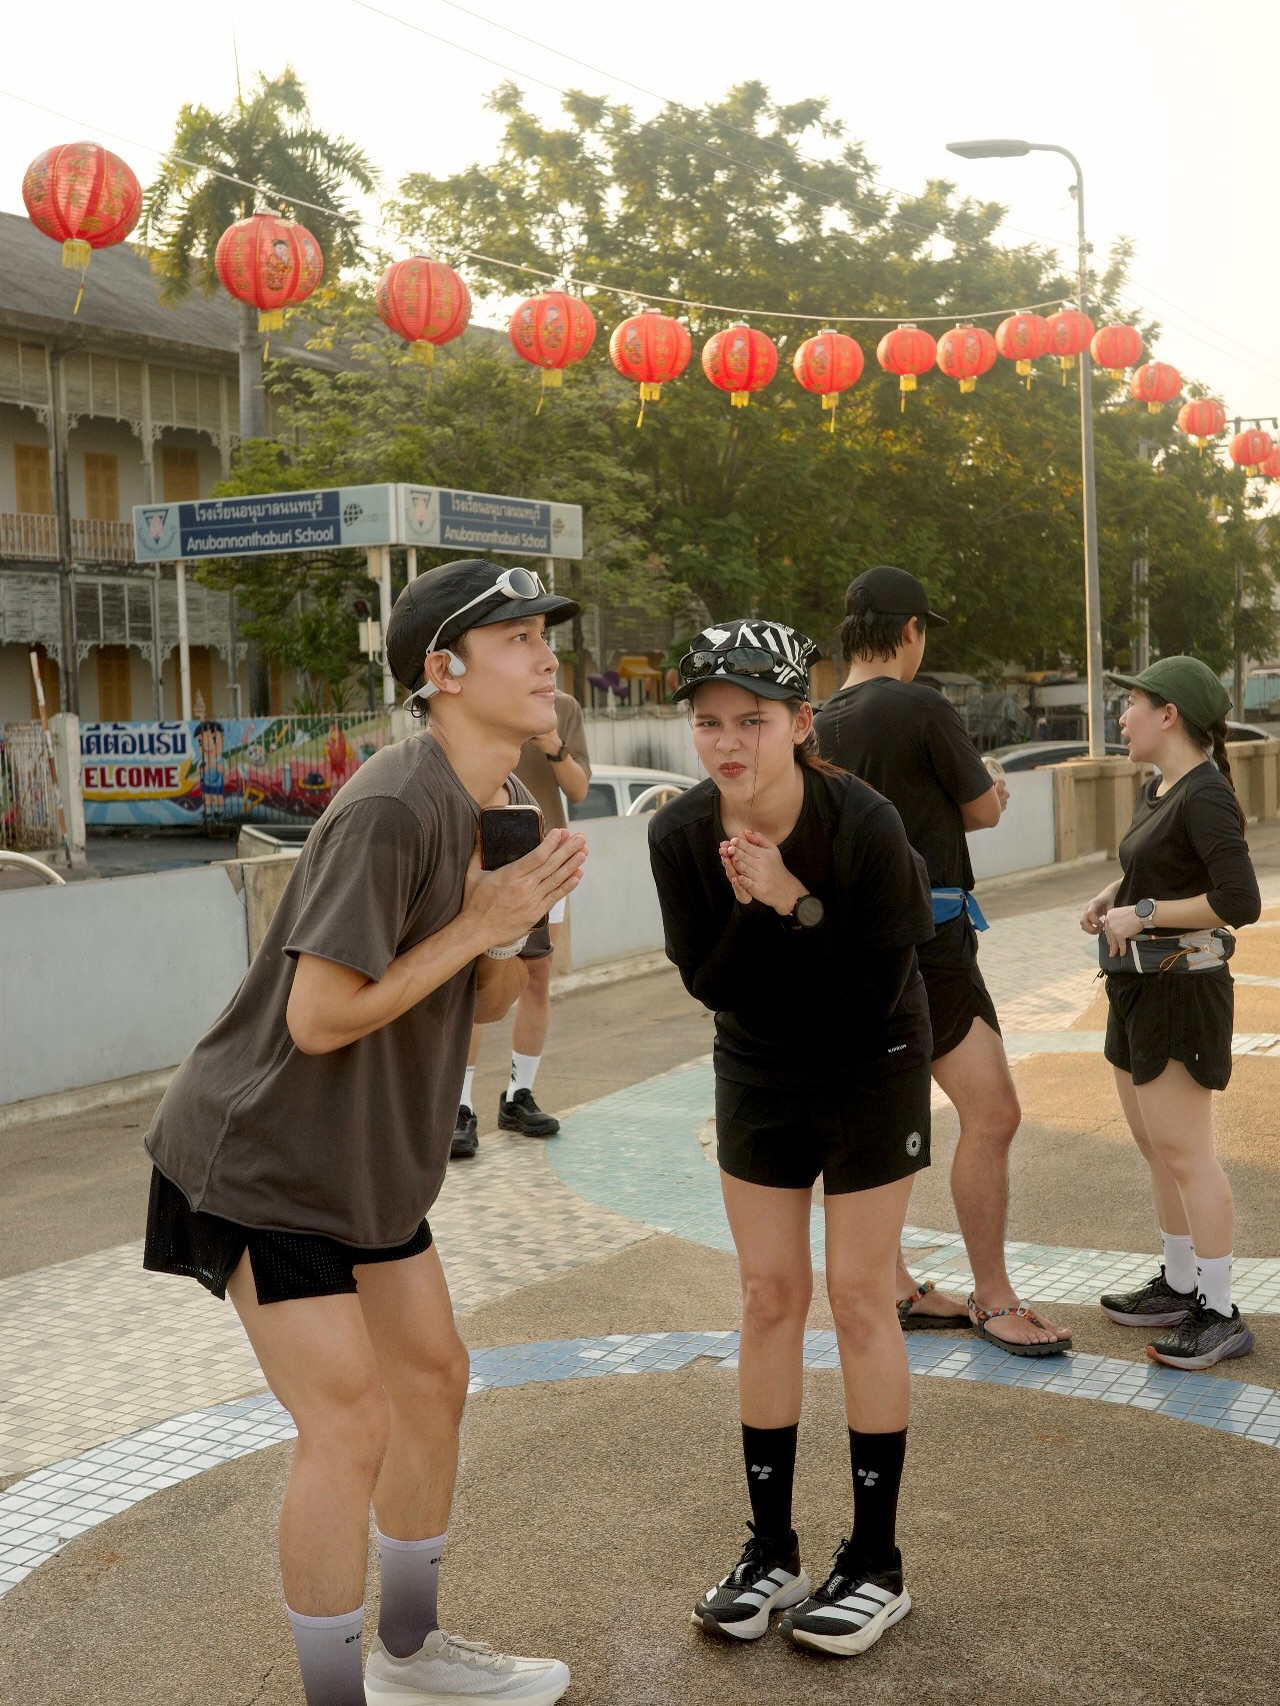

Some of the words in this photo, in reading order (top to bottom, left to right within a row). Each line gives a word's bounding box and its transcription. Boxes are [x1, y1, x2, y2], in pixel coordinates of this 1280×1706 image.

[194, 493, 323, 524] โรงเรียนอนุบาลนนทบุรี
[187, 529, 292, 551] Anubannonthaburi
[295, 525, 334, 544] School
[521, 533, 547, 549] School
[83, 766, 179, 788] ELCOME
